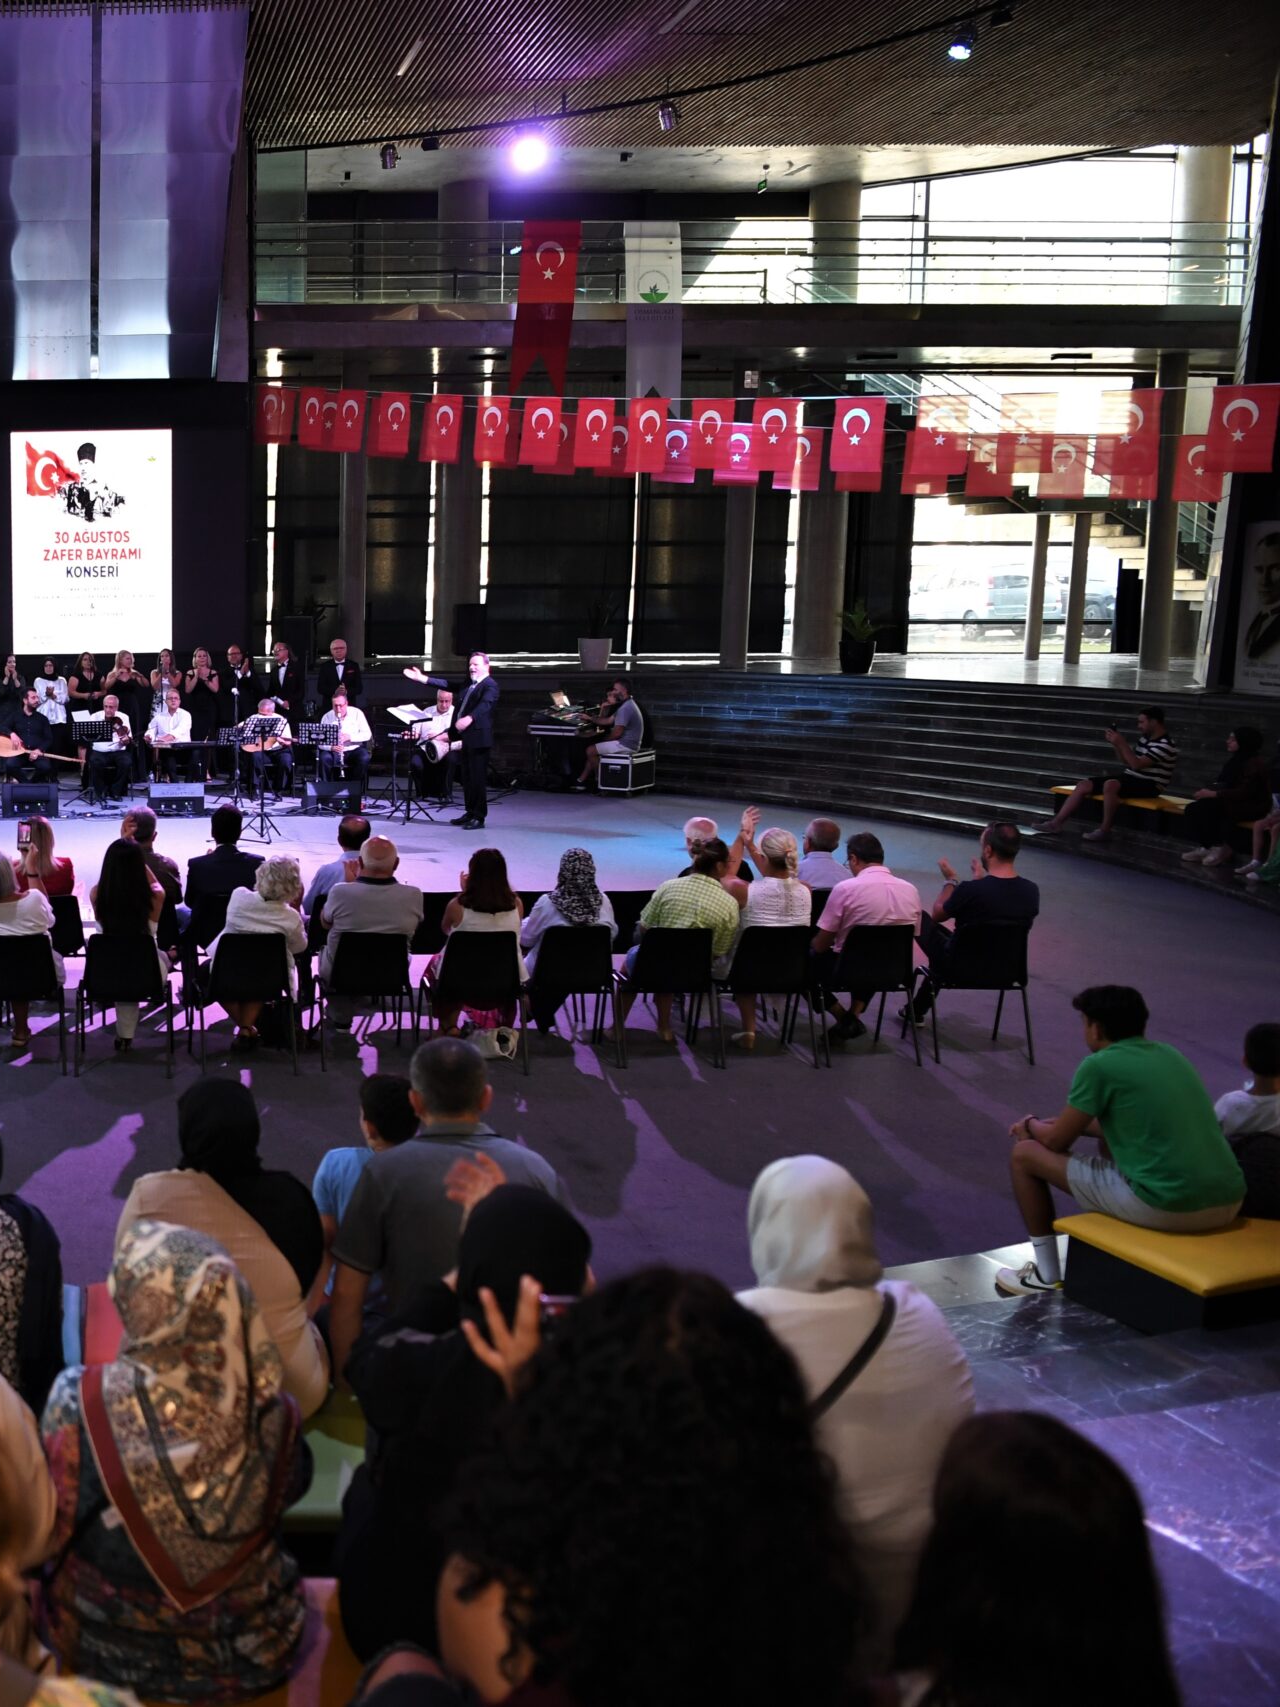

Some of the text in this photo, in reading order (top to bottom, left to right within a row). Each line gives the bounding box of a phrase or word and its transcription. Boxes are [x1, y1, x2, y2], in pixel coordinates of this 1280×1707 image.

[55, 529, 130, 543] 30 AĞUSTOS
[43, 548, 141, 561] ZAFER BAYRAMI
[66, 563, 119, 578] KONSERİ
